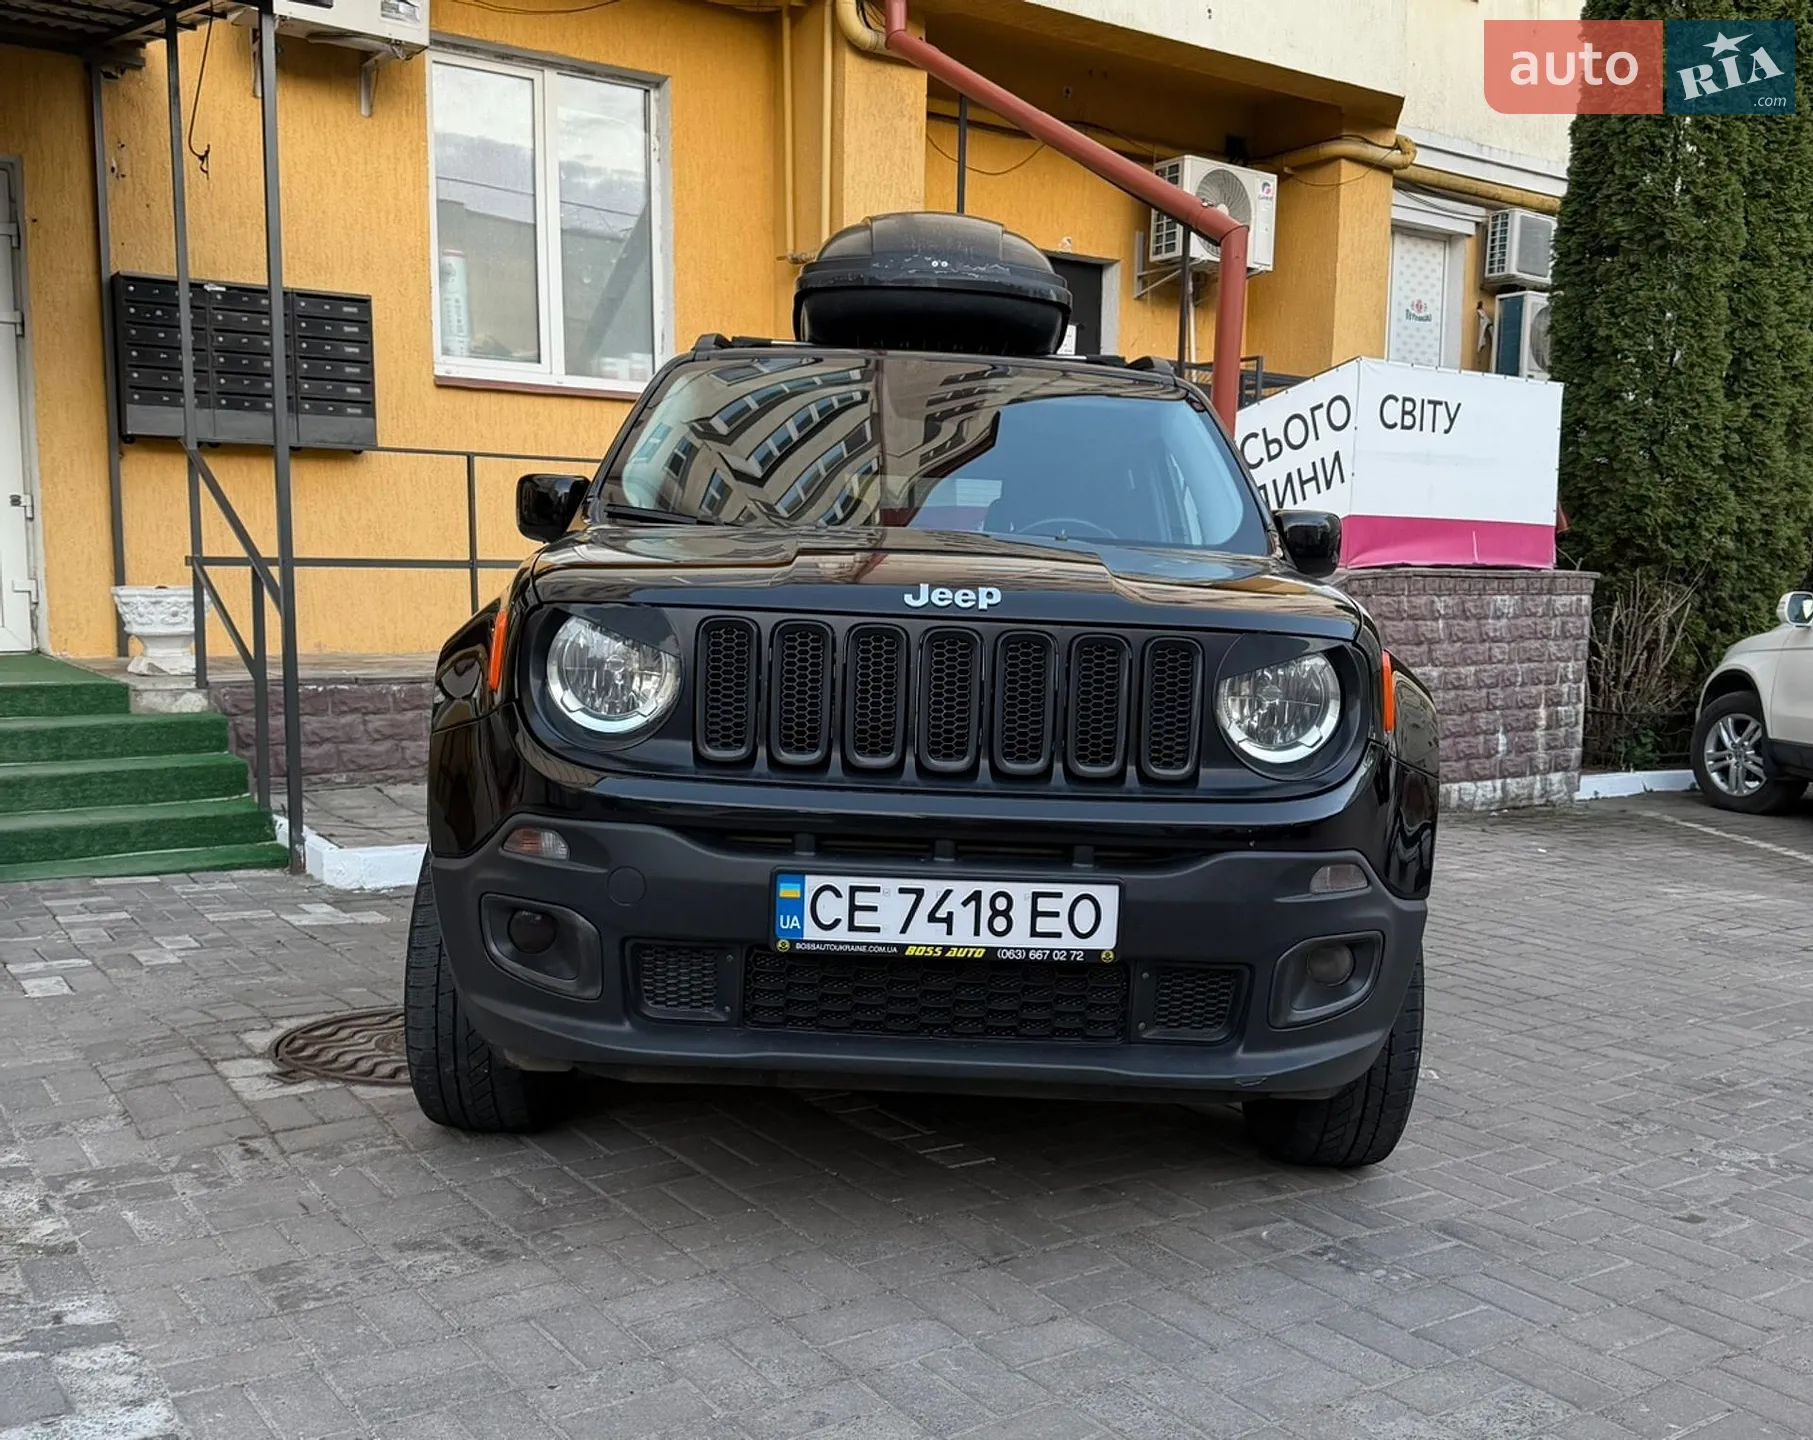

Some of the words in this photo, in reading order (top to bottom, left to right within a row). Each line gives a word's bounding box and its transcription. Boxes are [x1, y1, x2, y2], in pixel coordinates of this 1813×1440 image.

[1379, 394, 1461, 434] СВІТУ
[904, 583, 1002, 609] Jeep
[810, 884, 881, 933] CE
[898, 887, 1014, 937] 7418
[1029, 891, 1102, 939] EO
[779, 915, 801, 929] UA
[905, 946, 942, 957] BOSS
[945, 948, 986, 958] AUTO
[997, 950, 1026, 960] (063)
[1029, 951, 1049, 960] 667
[1053, 952, 1067, 961] 02
[1070, 952, 1084, 961] 72
